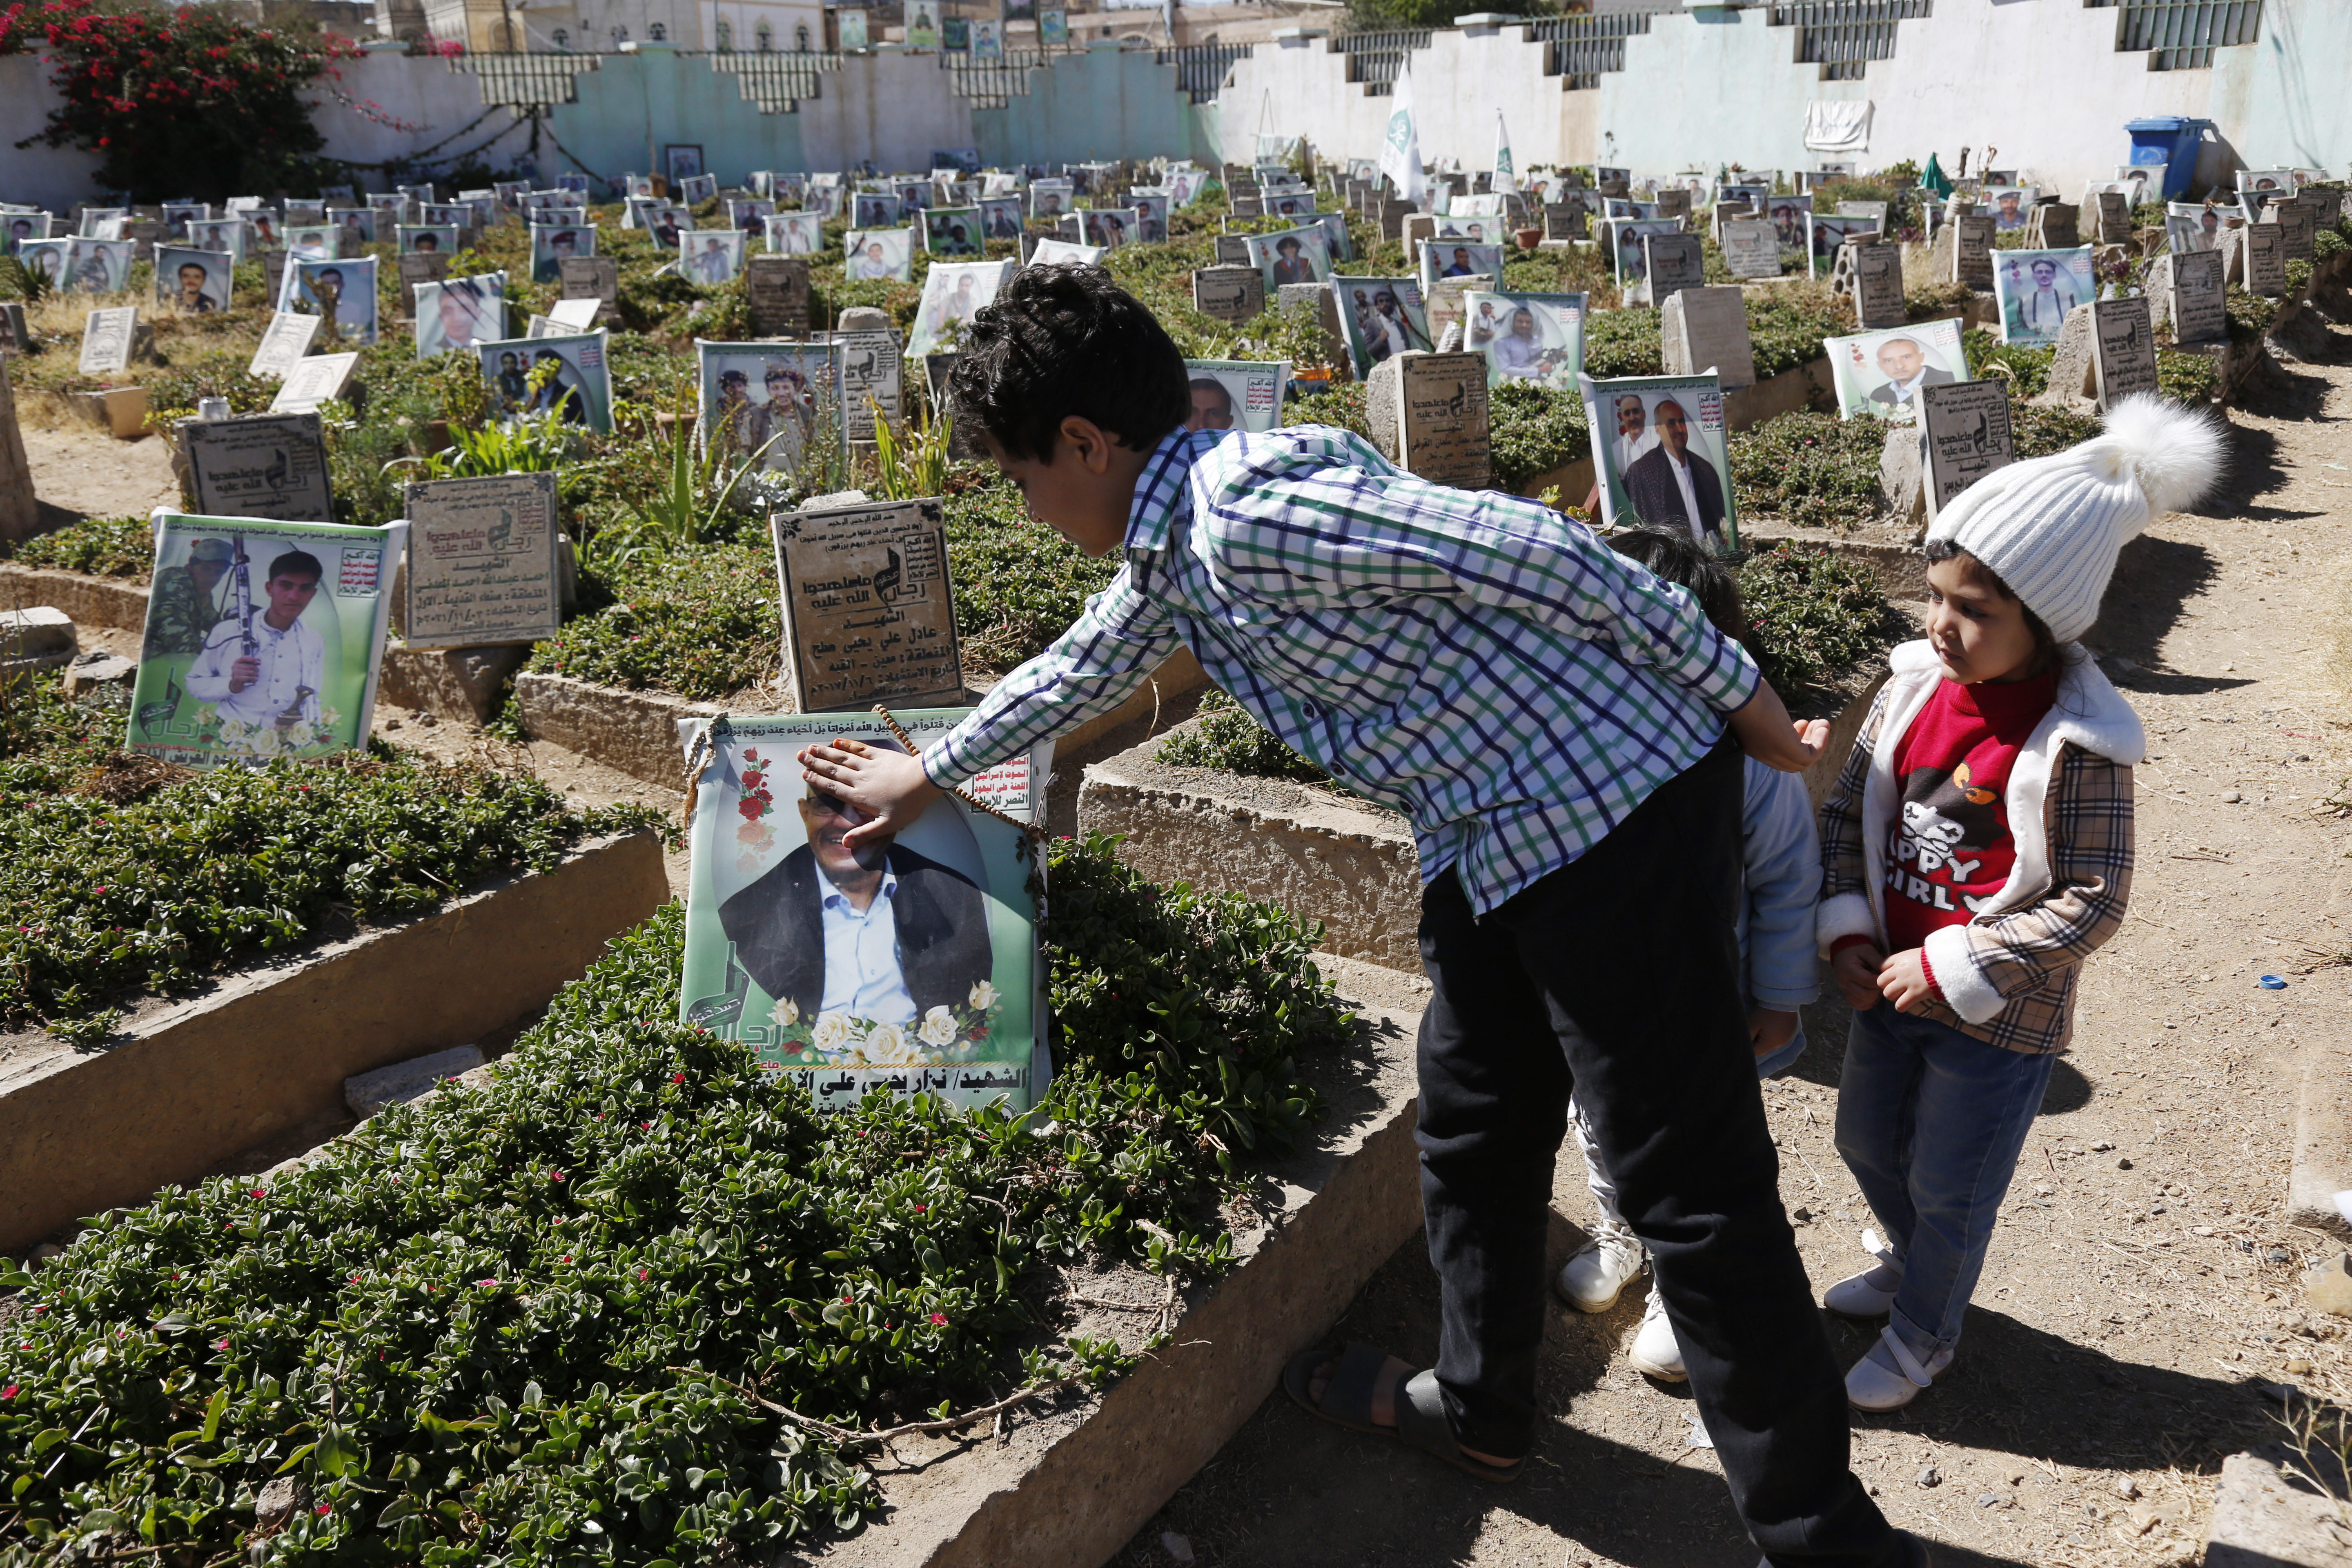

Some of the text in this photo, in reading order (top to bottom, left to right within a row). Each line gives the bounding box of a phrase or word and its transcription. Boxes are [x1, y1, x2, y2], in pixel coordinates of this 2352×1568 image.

[461, 540, 482, 551] الله
[452, 556, 510, 572] الشهيد
[811, 588, 869, 611] الله عليه
[843, 608, 905, 629] الشهيد
[880, 631, 901, 651] علي
[908, 626, 937, 644] عادل
[1005, 769, 1029, 780] الموت
[974, 782, 1028, 794] اللعنة على اليهود
[1003, 792, 1028, 808] النصر
[819, 1071, 855, 1100] علي
[910, 1068, 948, 1094] نزار
